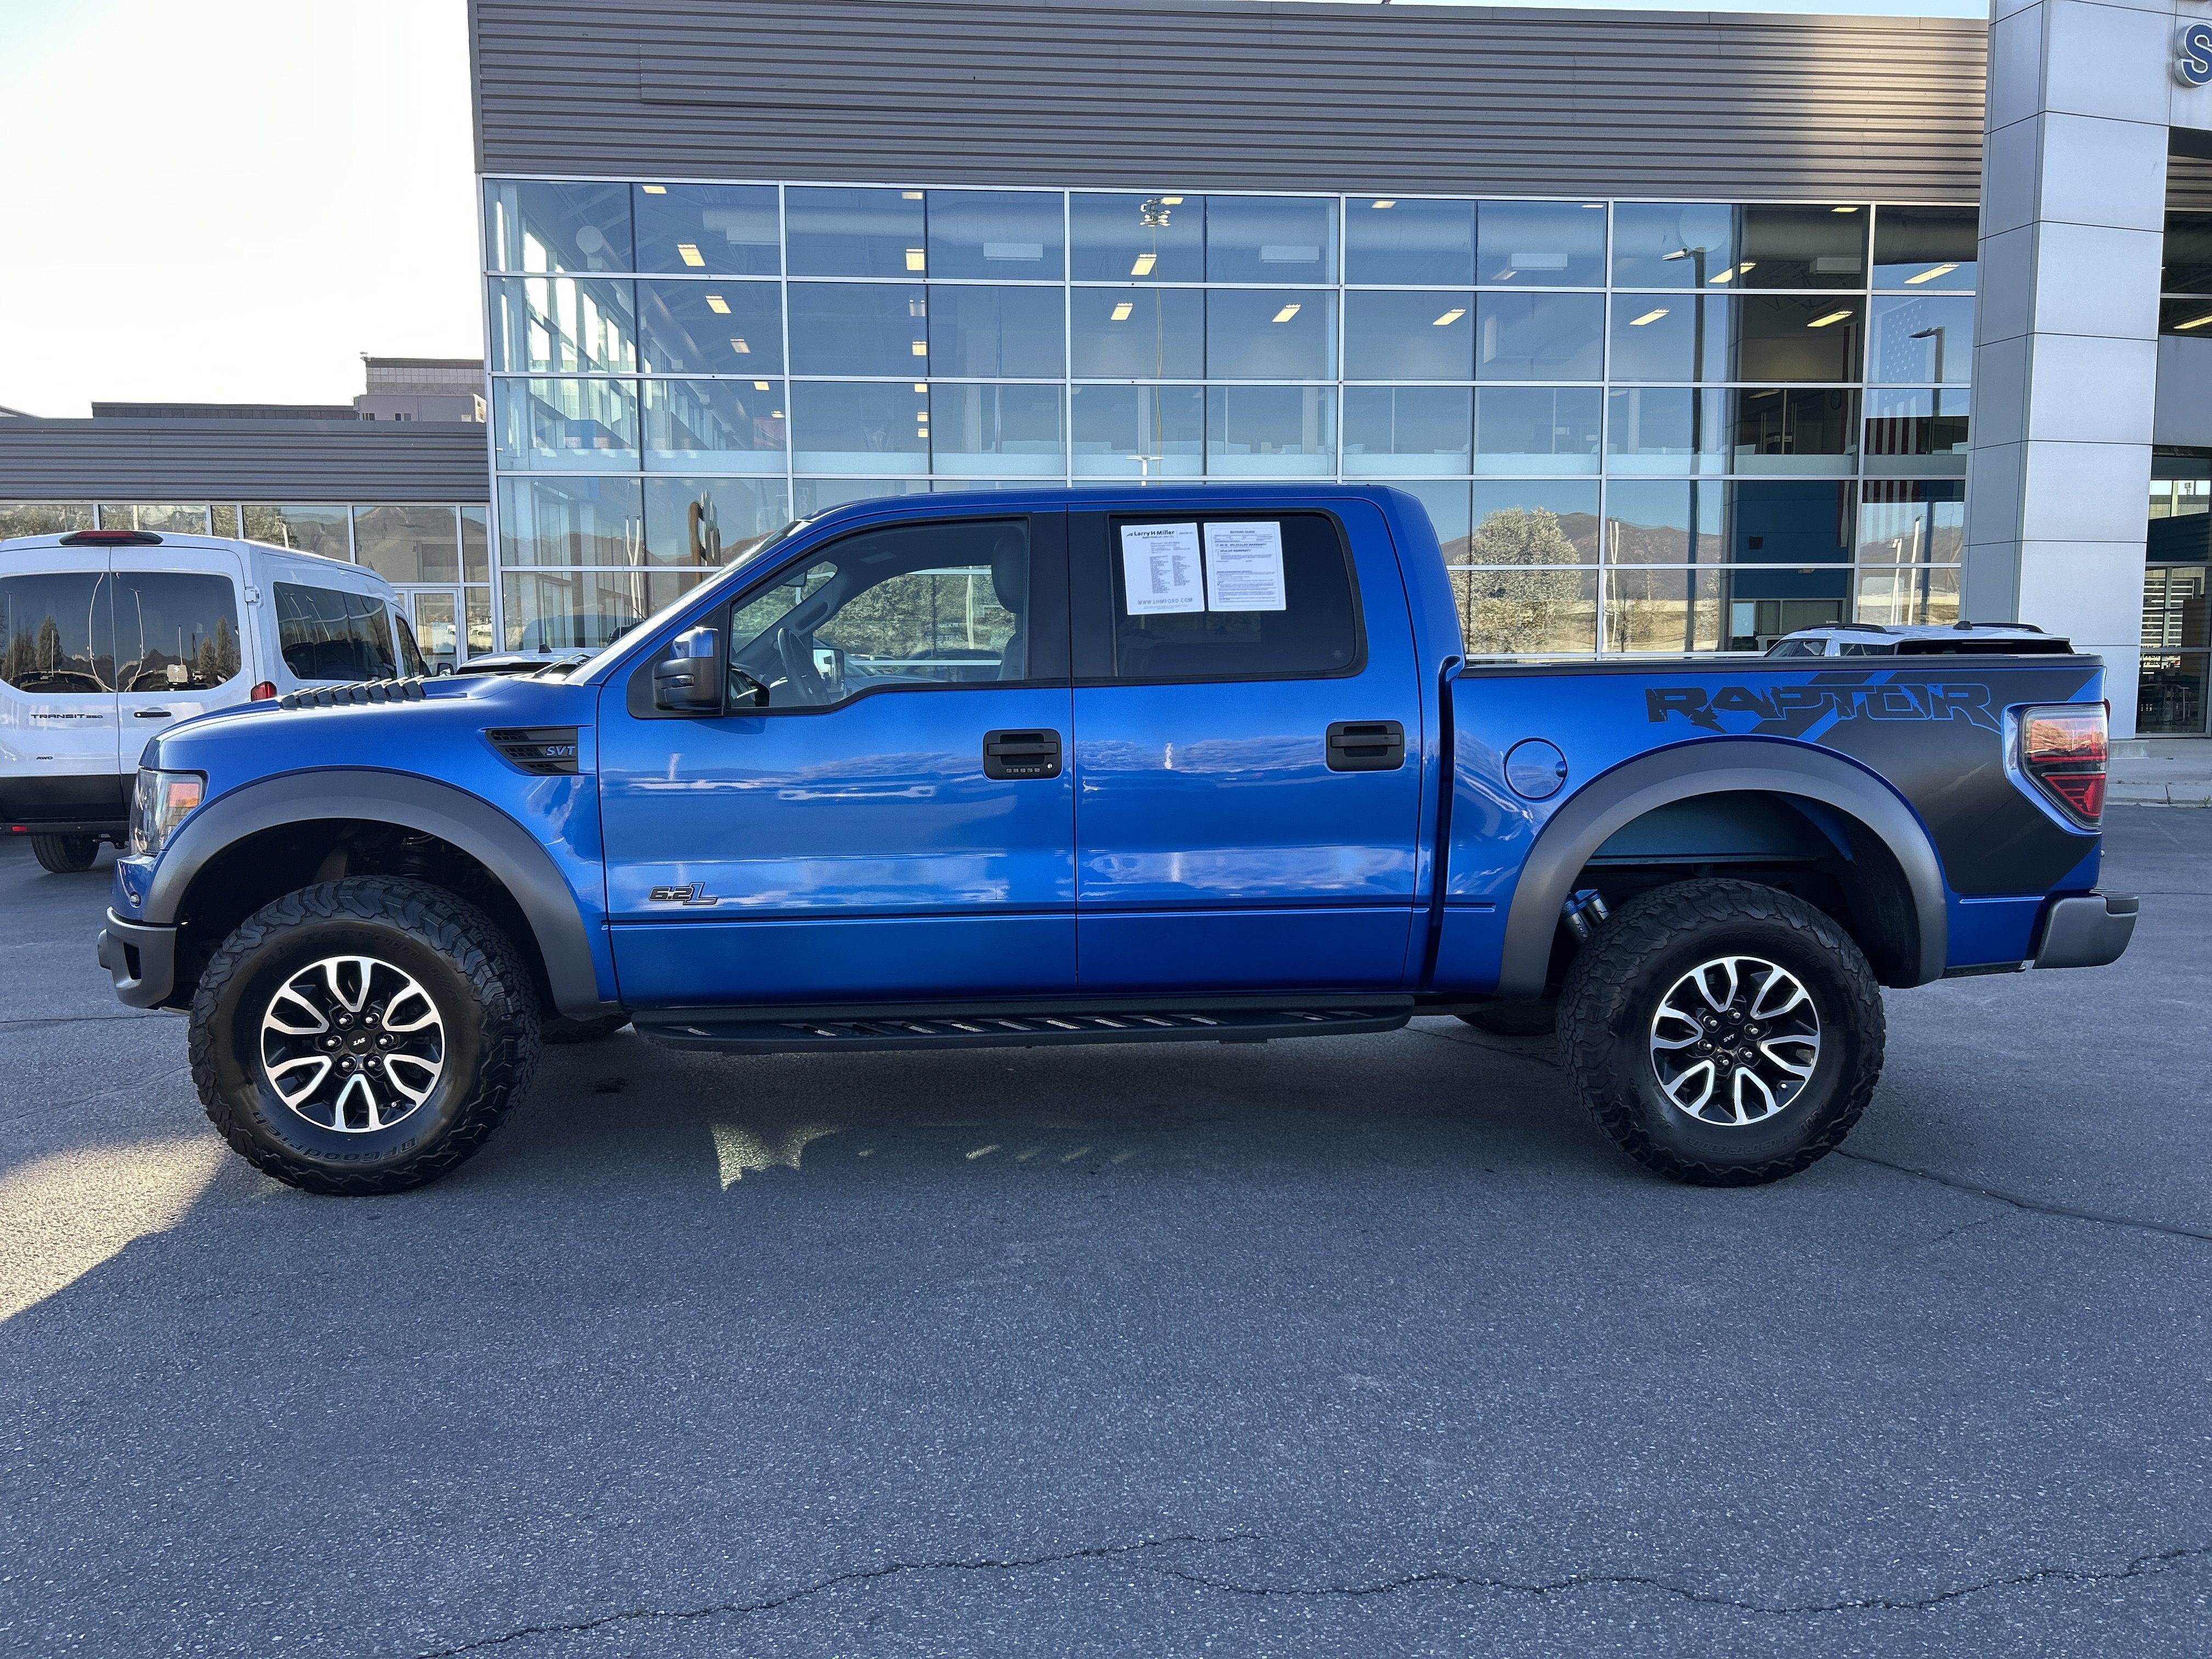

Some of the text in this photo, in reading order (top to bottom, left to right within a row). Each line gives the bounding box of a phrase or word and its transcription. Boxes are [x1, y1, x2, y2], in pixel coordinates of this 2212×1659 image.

[1645, 684, 2002, 735] RAPTOR
[546, 746, 575, 756] SVT
[649, 882, 718, 905] 6.2L
[352, 1036, 366, 1046] SVT
[1723, 1034, 1735, 1043] SVT
[252, 1110, 418, 1162] BFGoodrich
